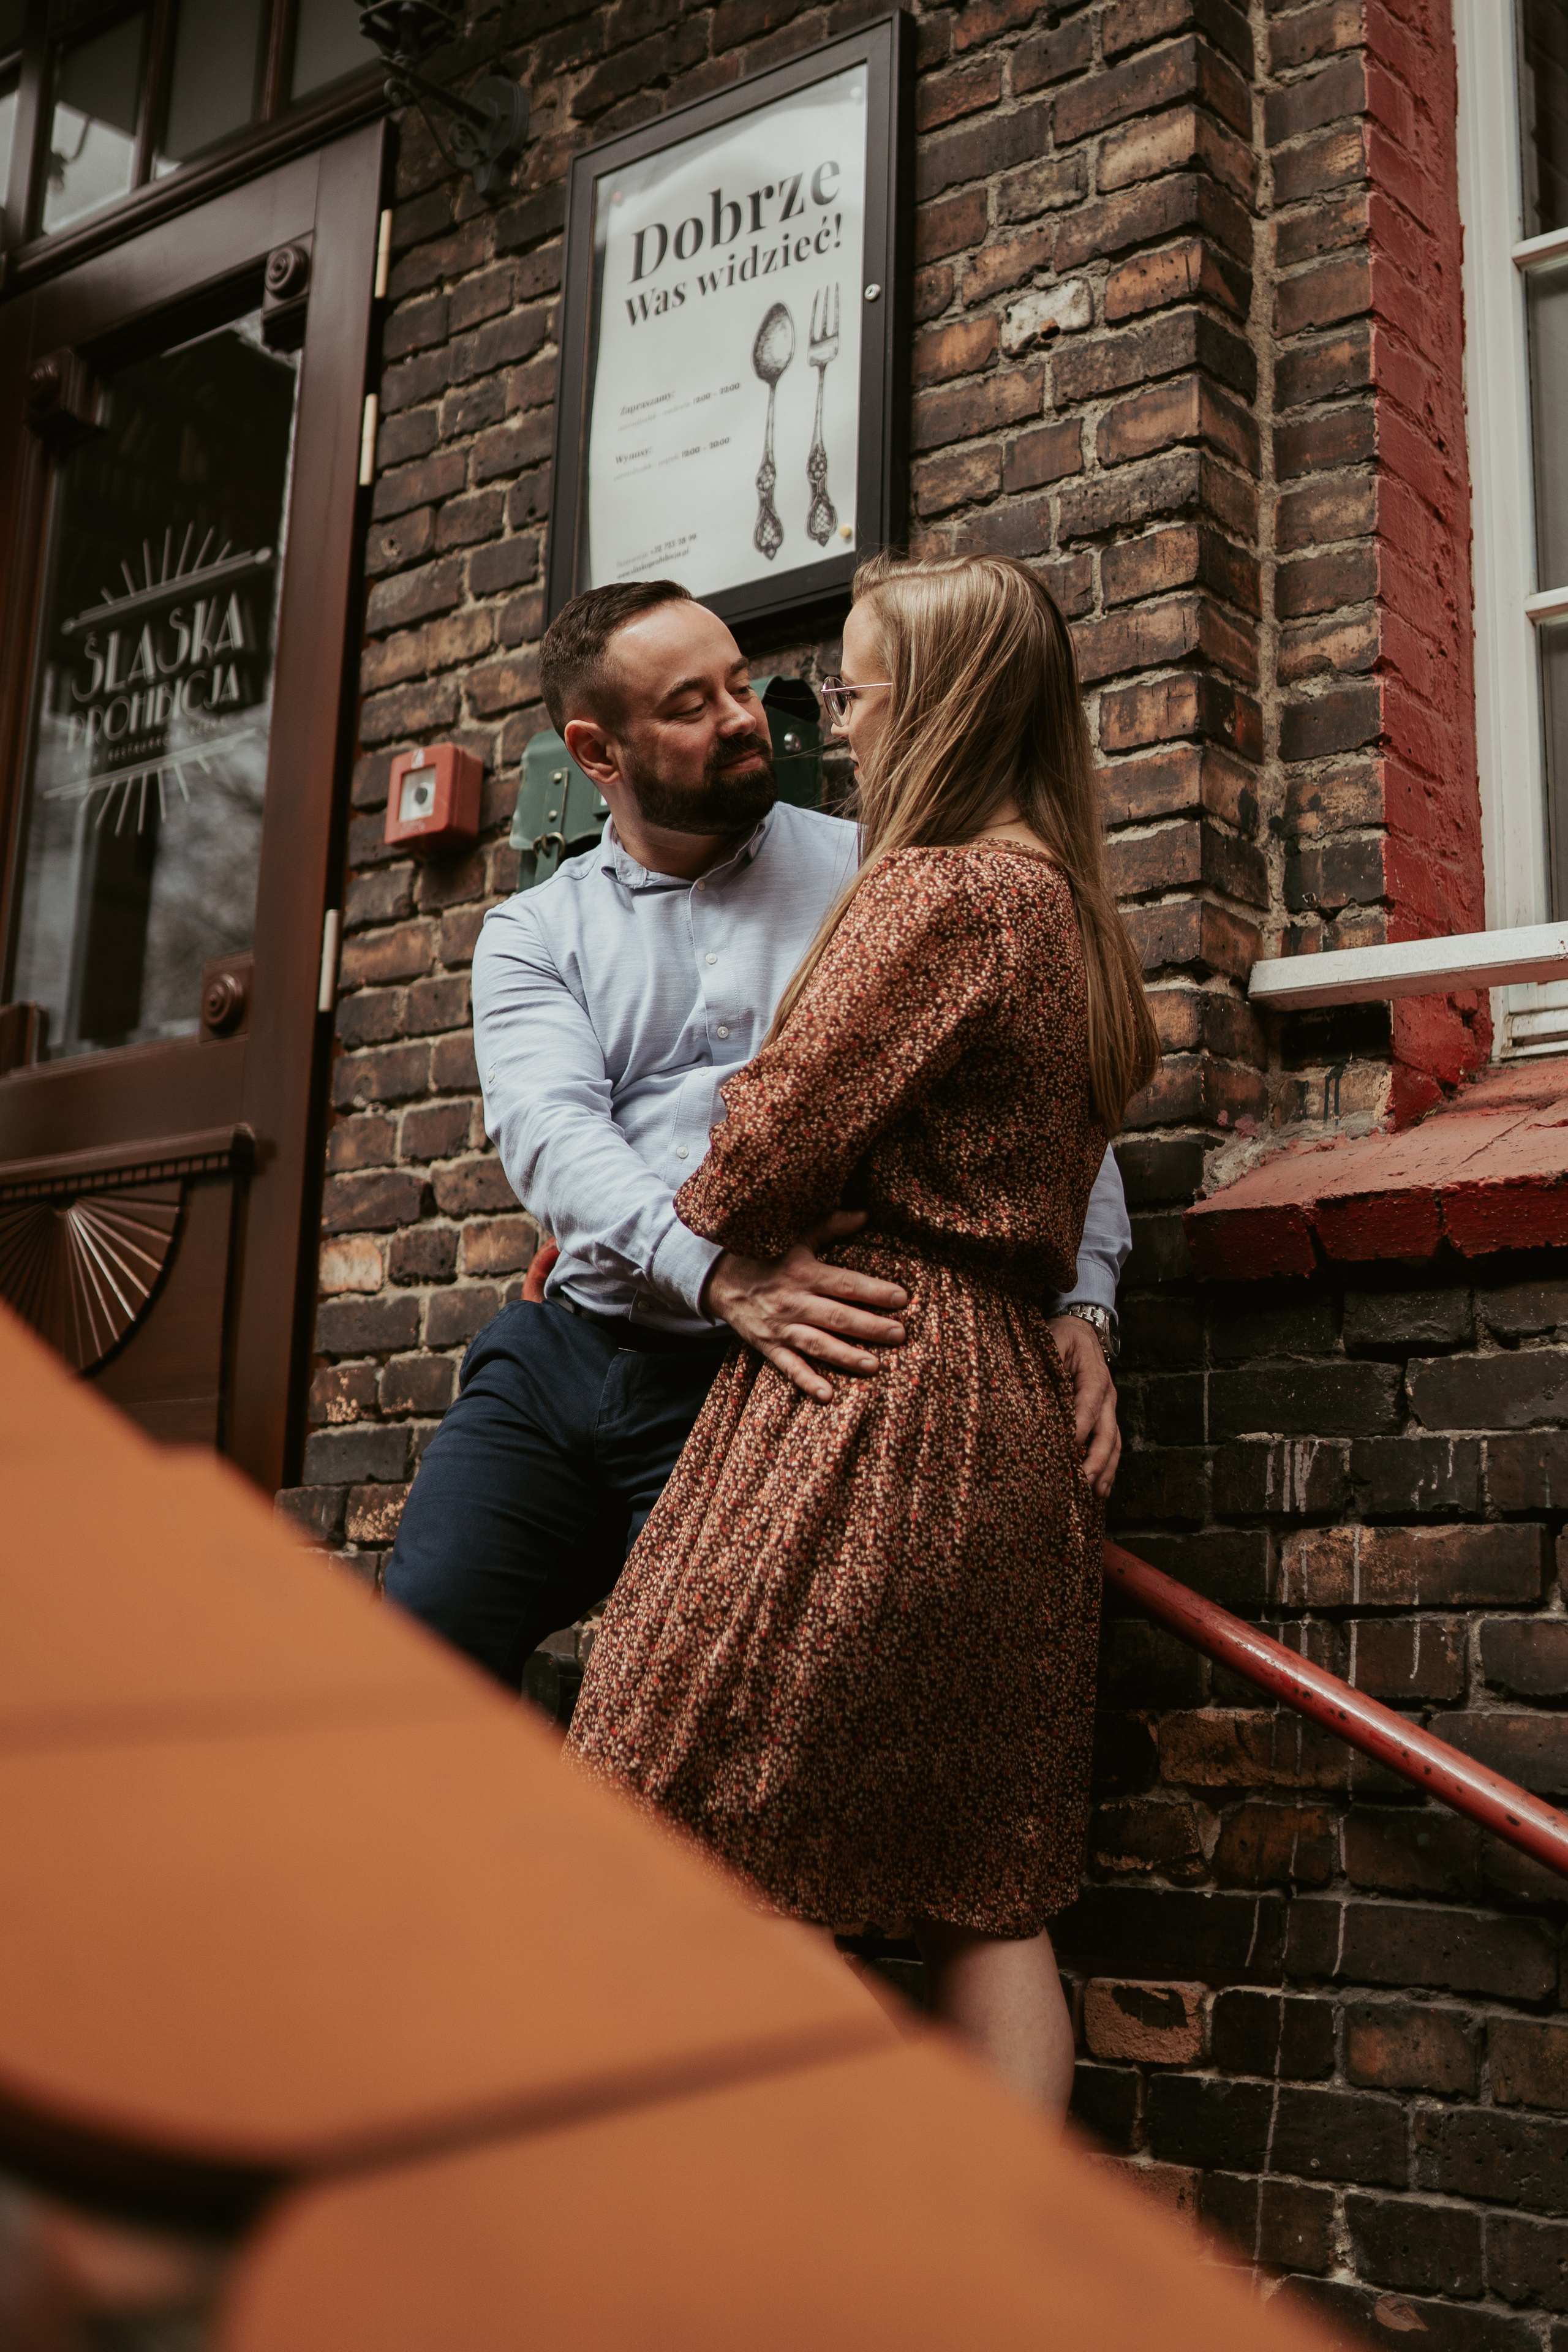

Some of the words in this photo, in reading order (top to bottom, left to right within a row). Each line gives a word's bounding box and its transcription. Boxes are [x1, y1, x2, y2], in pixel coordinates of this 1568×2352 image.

[624, 279, 687, 327] Was
[696, 212, 843, 297] widzieć!
[627, 159, 840, 285] Dobrze
[67, 661, 239, 753] PROHIBICJA
